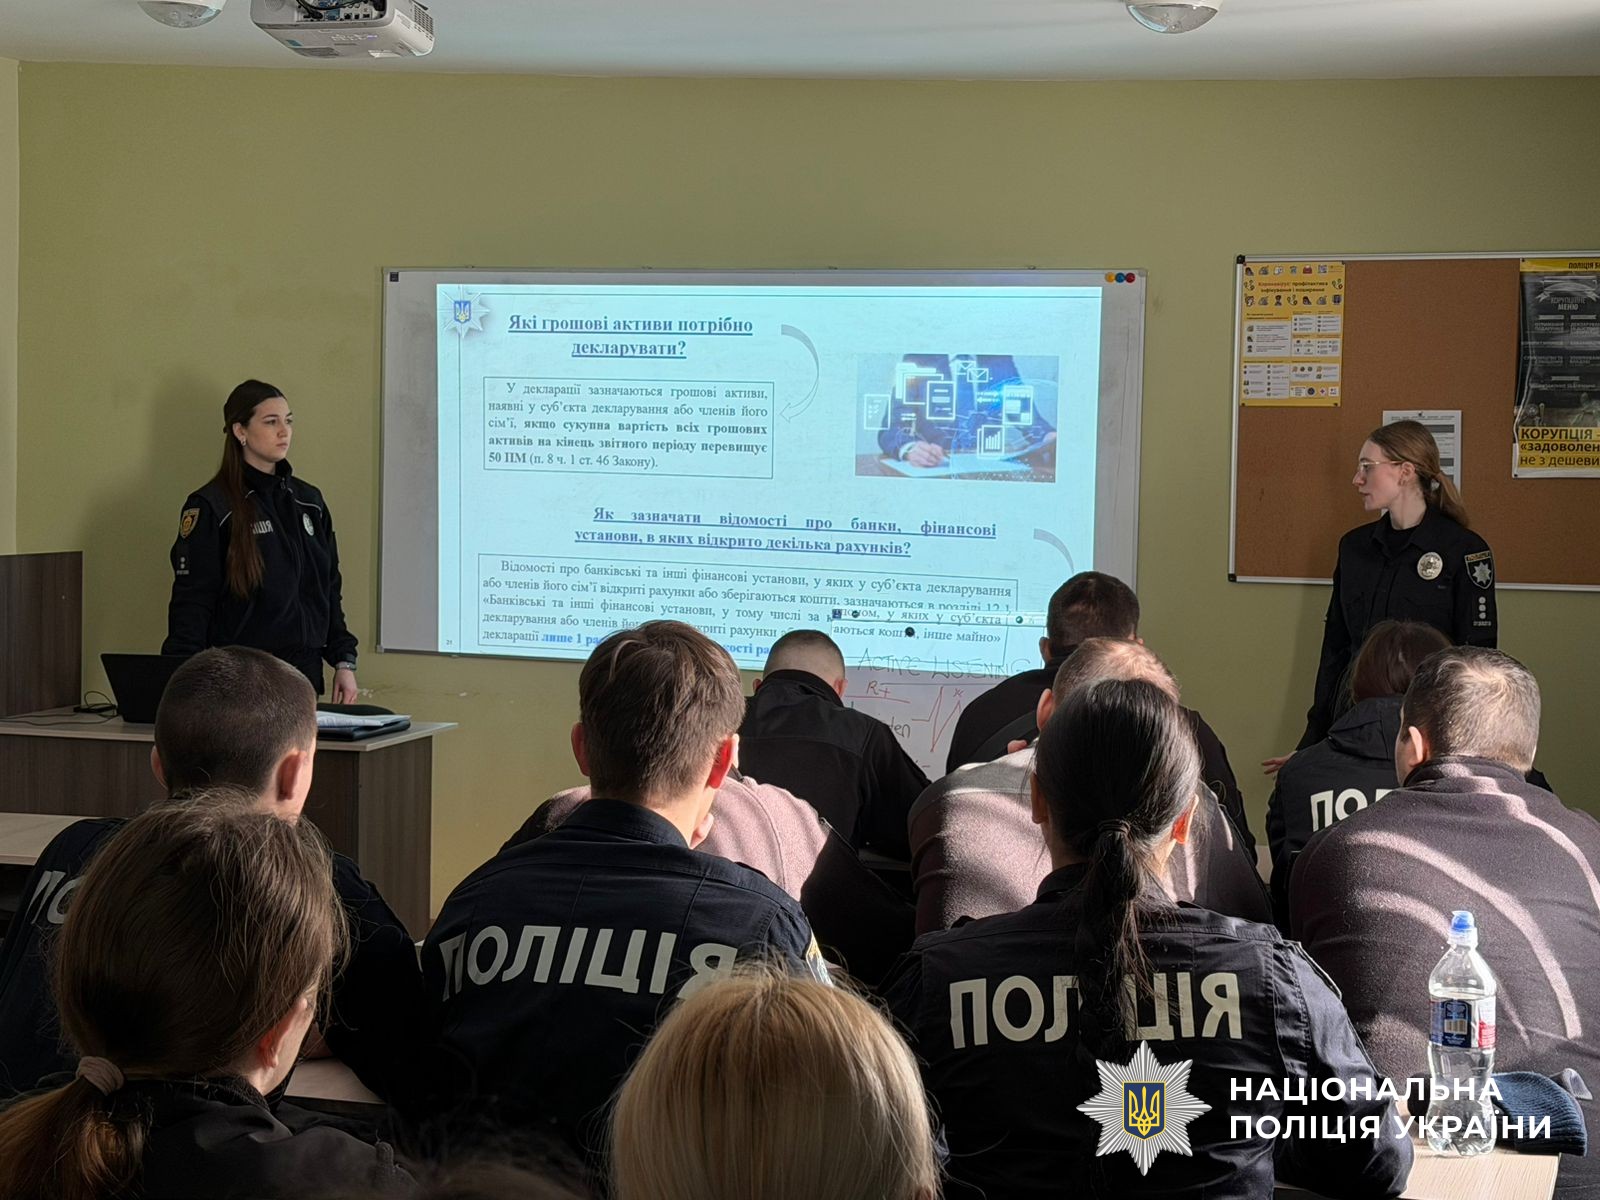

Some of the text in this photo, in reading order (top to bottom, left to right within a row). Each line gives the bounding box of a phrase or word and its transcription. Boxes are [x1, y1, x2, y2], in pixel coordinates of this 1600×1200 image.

[508, 315, 753, 334] Які грошові активи потрібно
[571, 341, 687, 357] декларувати?
[506, 382, 768, 400] У декларації зазначаються грошові активи,
[488, 400, 524, 412] наявні
[528, 403, 536, 414] у
[591, 404, 669, 417] декларування
[673, 403, 694, 415] або
[698, 404, 736, 416] членів
[741, 405, 768, 417] його
[524, 420, 556, 430] якщо
[563, 421, 611, 433] сукупна
[618, 421, 669, 434] вартість
[676, 422, 700, 433] всіх
[707, 425, 768, 436] грошових
[1521, 428, 1593, 442] КОРУПЦІЯ
[488, 435, 768, 456] активів на кінець звітного періоду перевищує
[488, 452, 658, 470] 50 ПМ (п. 8 ч. 1 ст. 46 Закону).
[1520, 456, 1536, 465] не
[1539, 456, 1546, 465] з
[593, 507, 996, 537] Як зазначати відомості про банки, фінансові
[575, 530, 911, 555] установи, в яких відкрито декілька рахунків?
[501, 560, 555, 573] Відомості
[560, 565, 580, 577] про
[584, 563, 641, 577] банківські
[646, 569, 658, 578] та
[662, 567, 687, 579] інші
[692, 569, 748, 583] фінансові
[752, 573, 809, 587] установи,
[813, 577, 821, 589] у
[825, 578, 854, 588] яких
[858, 580, 866, 591] у
[926, 583, 1012, 598] декларування
[482, 577, 501, 588] або
[504, 579, 540, 590] членів
[543, 580, 568, 592] його
[600, 582, 646, 596] відкриті
[649, 587, 695, 599] рахунки
[698, 587, 718, 599] або
[721, 588, 796, 603] зберігаються
[843, 597, 924, 609] зазначаються
[552, 599, 564, 608] та
[570, 597, 594, 609] інші
[600, 598, 654, 613] фінансові
[660, 603, 716, 617] установи,
[722, 608, 729, 619] у
[735, 609, 764, 621] тому
[770, 609, 801, 621] числі
[808, 613, 819, 622] за
[887, 611, 895, 621] у
[900, 611, 929, 620] яких
[936, 613, 944, 624] у
[482, 613, 557, 625] декларування
[560, 615, 579, 625] або
[583, 616, 618, 628] членів
[730, 626, 777, 638] рахунки
[833, 625, 875, 636] аються
[923, 628, 952, 640] інше
[482, 630, 540, 643] декларації
[541, 634, 573, 644] лише
[576, 633, 582, 644] 1
[949, 972, 1243, 1049] ПОЛЦІЯ
